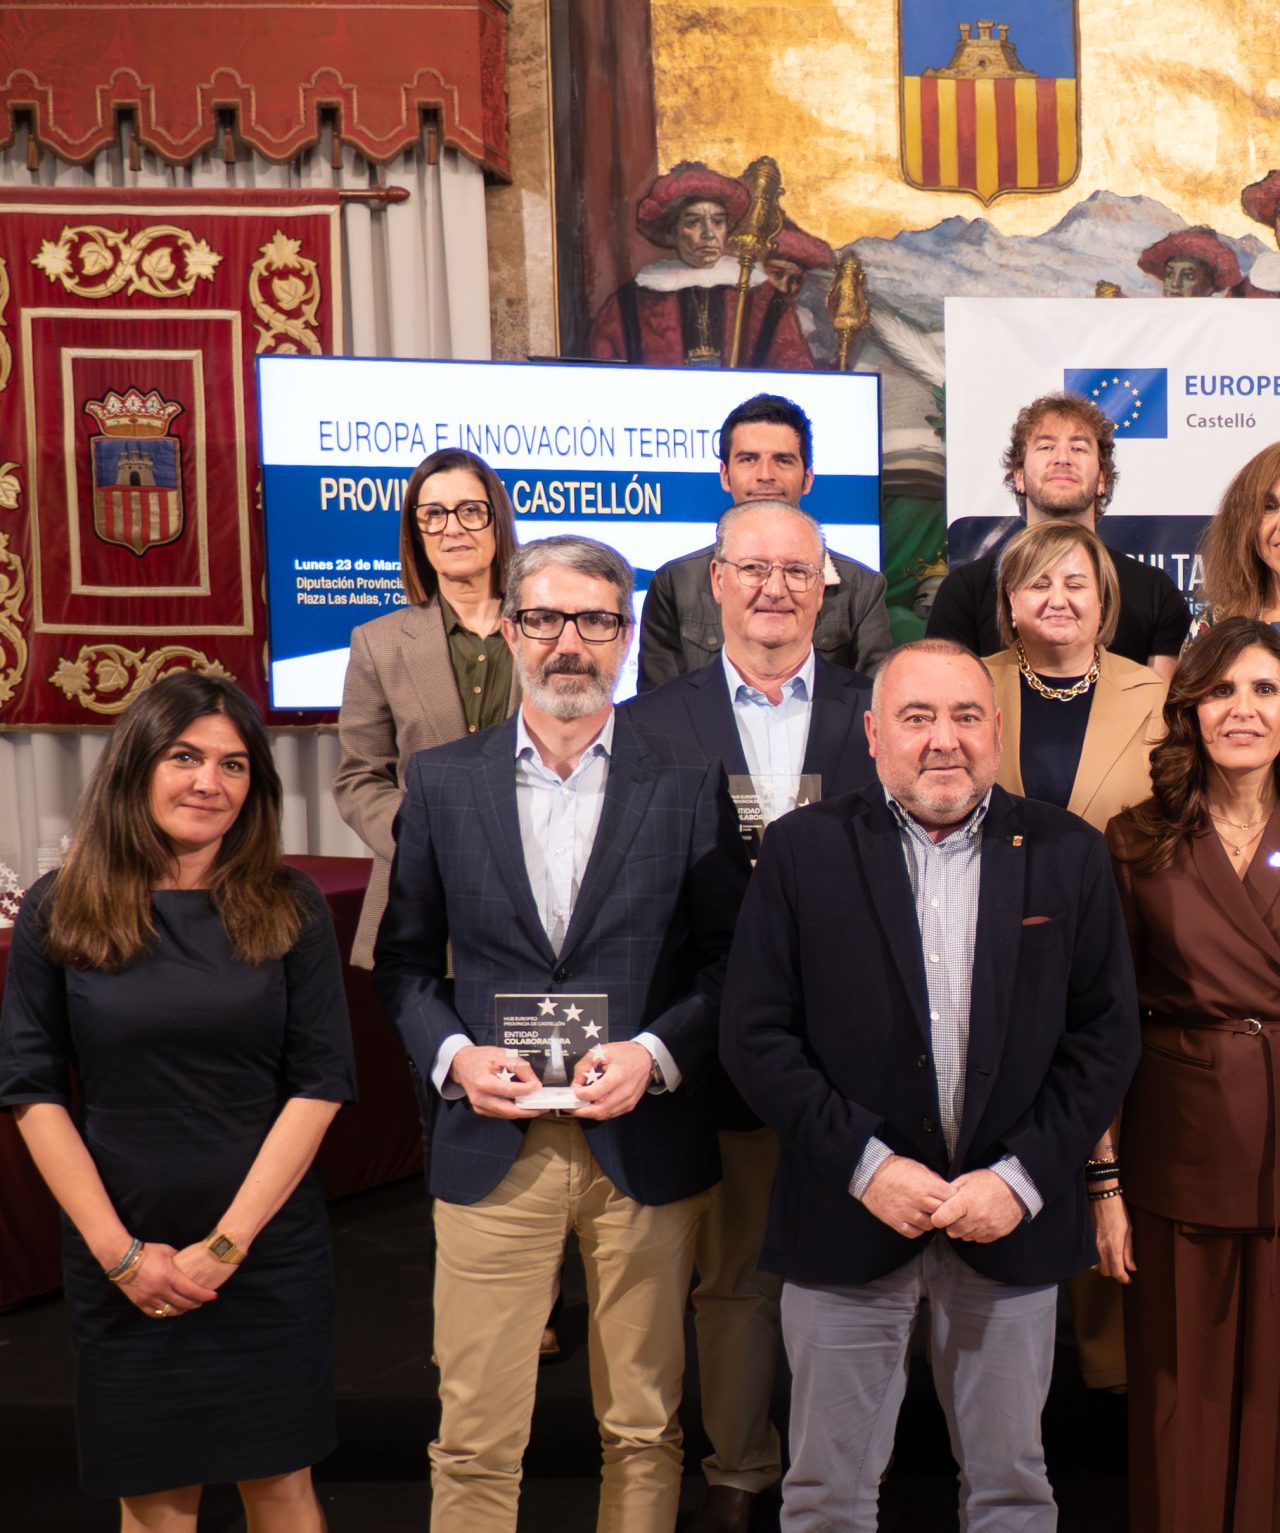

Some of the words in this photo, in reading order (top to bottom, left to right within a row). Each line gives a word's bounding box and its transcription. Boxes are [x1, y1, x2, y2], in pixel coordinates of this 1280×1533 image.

[1186, 413, 1256, 428] Castelló
[319, 421, 427, 453] EUROPA
[459, 419, 615, 458] INNOVACIÓN
[512, 474, 662, 516] CASTELLÓN
[294, 559, 334, 571] Lunes
[335, 559, 352, 571] 23
[354, 559, 371, 571] de
[296, 576, 355, 591] Diputación
[297, 592, 327, 605] Plaza
[328, 592, 348, 605] Las
[349, 592, 382, 607] Aulas,
[383, 593, 391, 605] 7
